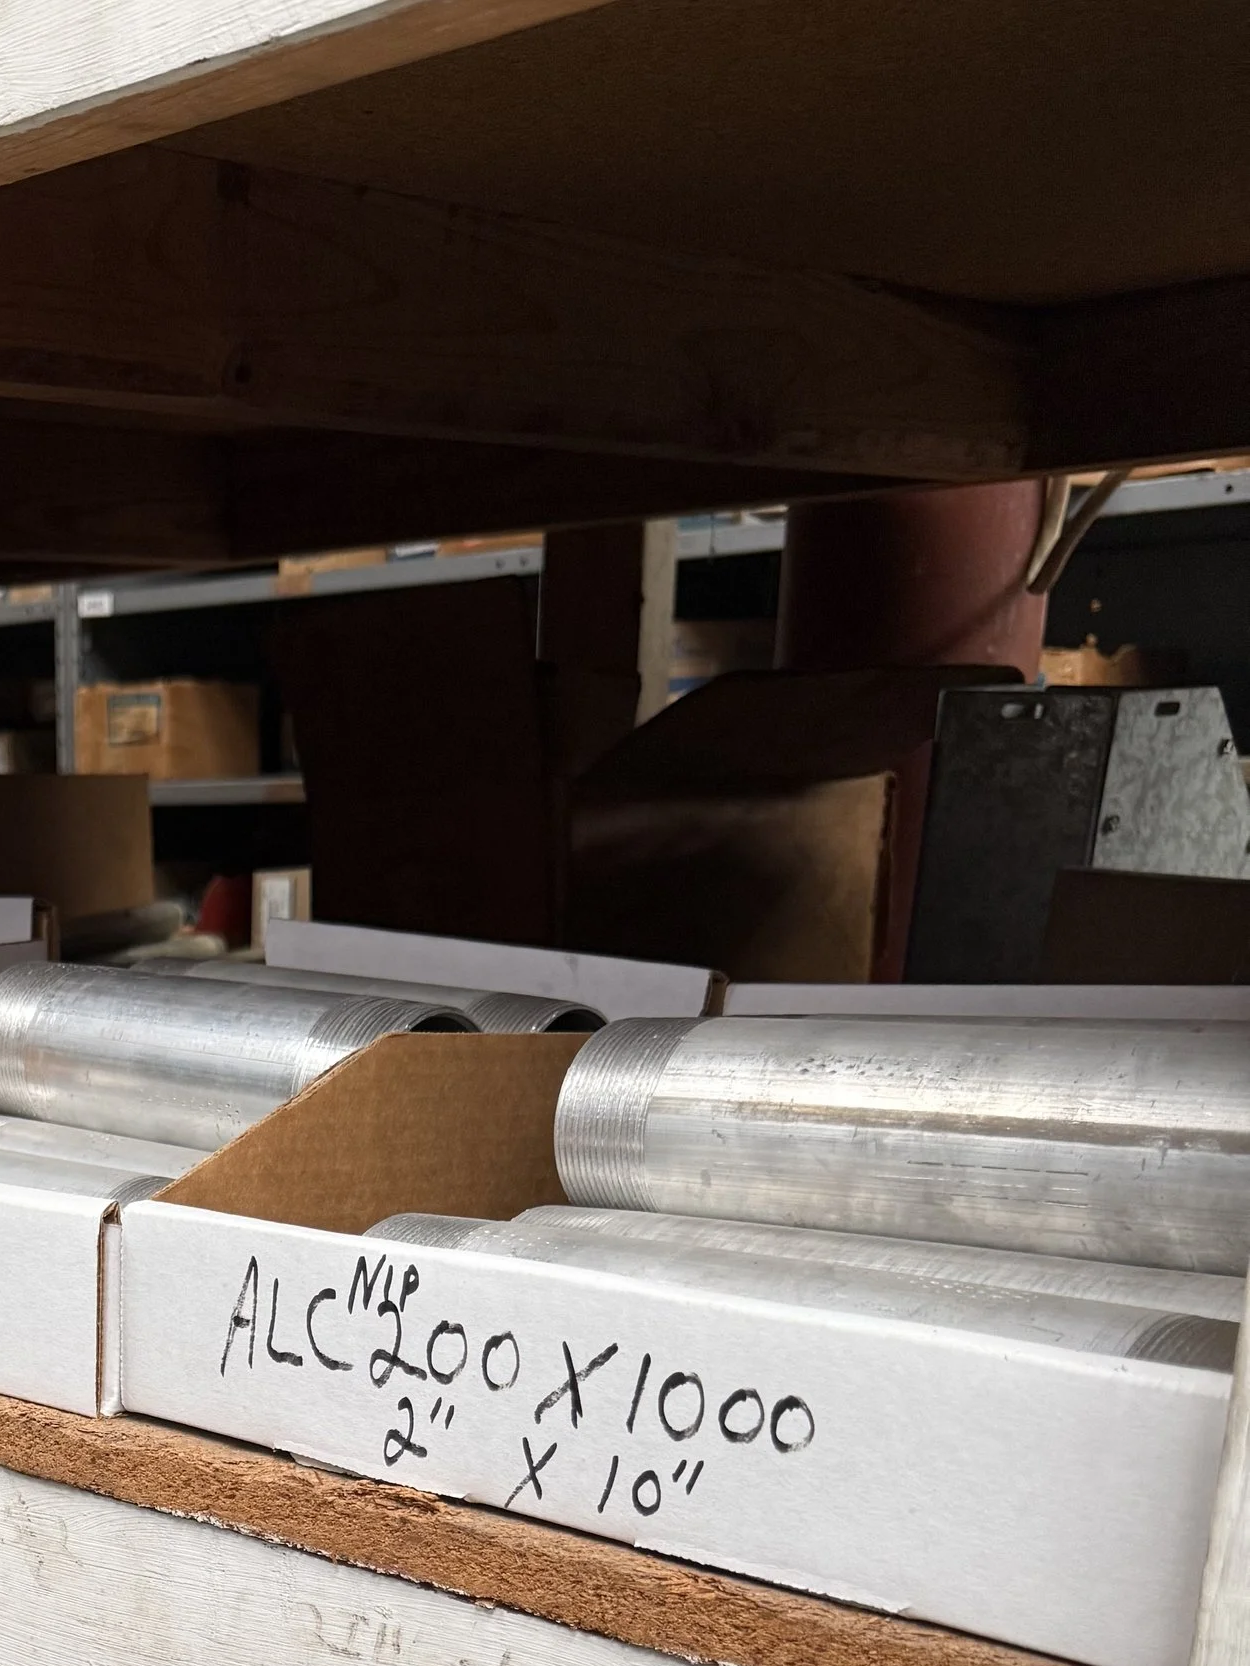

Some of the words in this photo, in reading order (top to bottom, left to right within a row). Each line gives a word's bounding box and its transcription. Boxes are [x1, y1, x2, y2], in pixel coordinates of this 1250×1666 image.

[220, 1255, 355, 1377] ALC
[346, 1253, 421, 1315] NIP
[369, 1299, 520, 1392] 200
[533, 1341, 619, 1430] X
[626, 1353, 816, 1454] 1000
[382, 1395, 456, 1467] 2"
[503, 1436, 558, 1509] X
[597, 1454, 705, 1516] 10"
